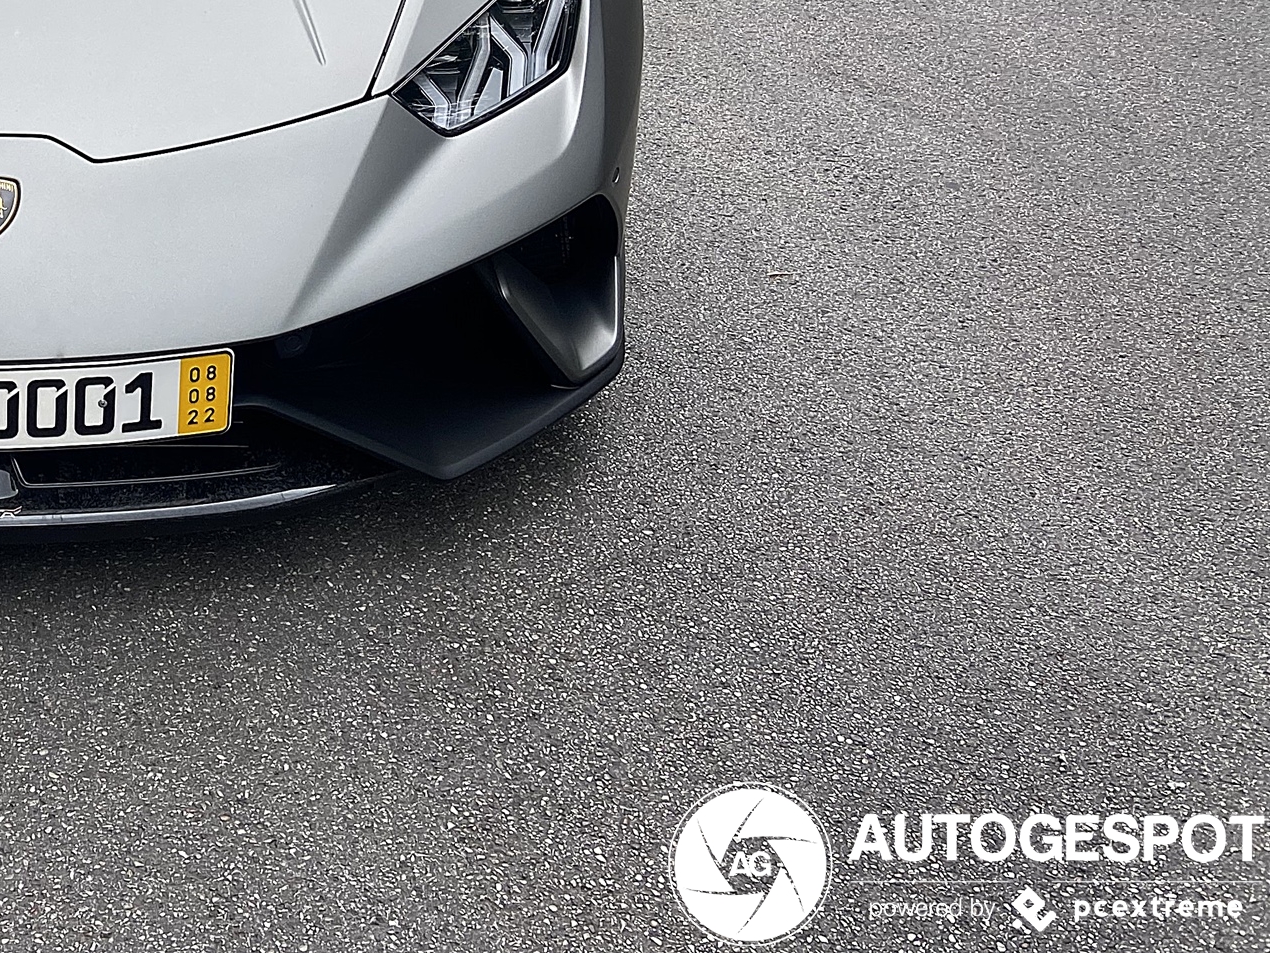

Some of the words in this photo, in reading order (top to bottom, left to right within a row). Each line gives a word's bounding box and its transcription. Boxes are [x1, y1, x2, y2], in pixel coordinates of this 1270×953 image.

[189, 365, 217, 383] 08
[189, 386, 216, 404] 08
[187, 407, 215, 425] 22
